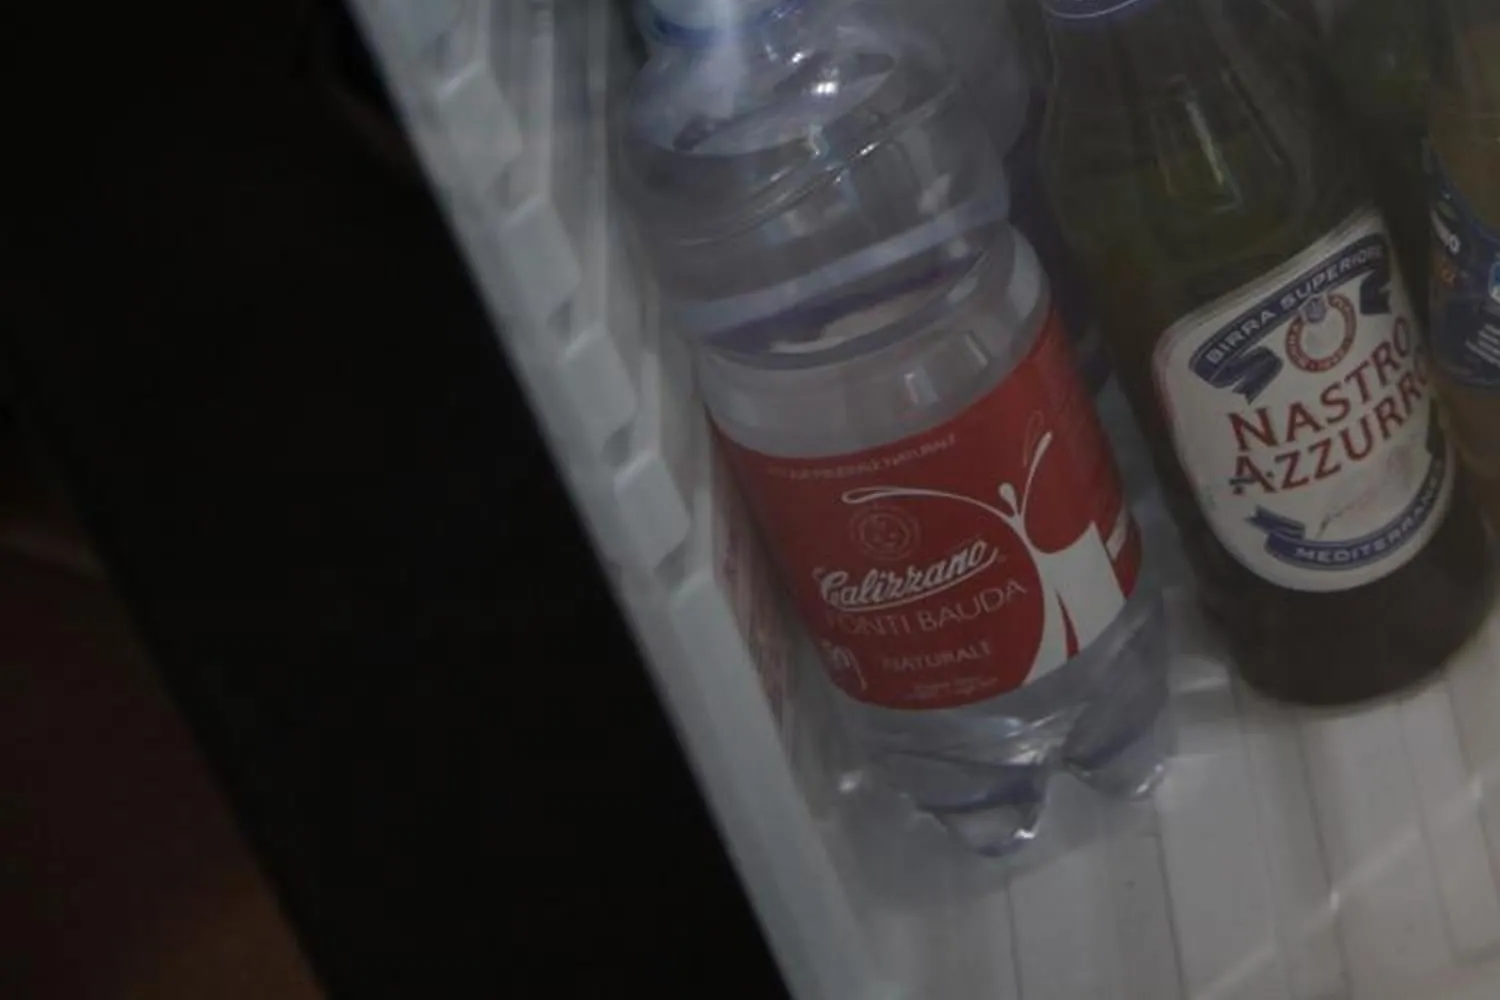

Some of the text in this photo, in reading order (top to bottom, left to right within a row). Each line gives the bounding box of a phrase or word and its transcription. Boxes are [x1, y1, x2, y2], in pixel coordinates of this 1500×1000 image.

[1205, 308, 1278, 367] BIRRA
[1279, 243, 1386, 309] SUPERIORE
[1227, 316, 1412, 453] NASTRO
[917, 578, 1030, 634] BAUDA
[881, 640, 993, 673] NATURALE
